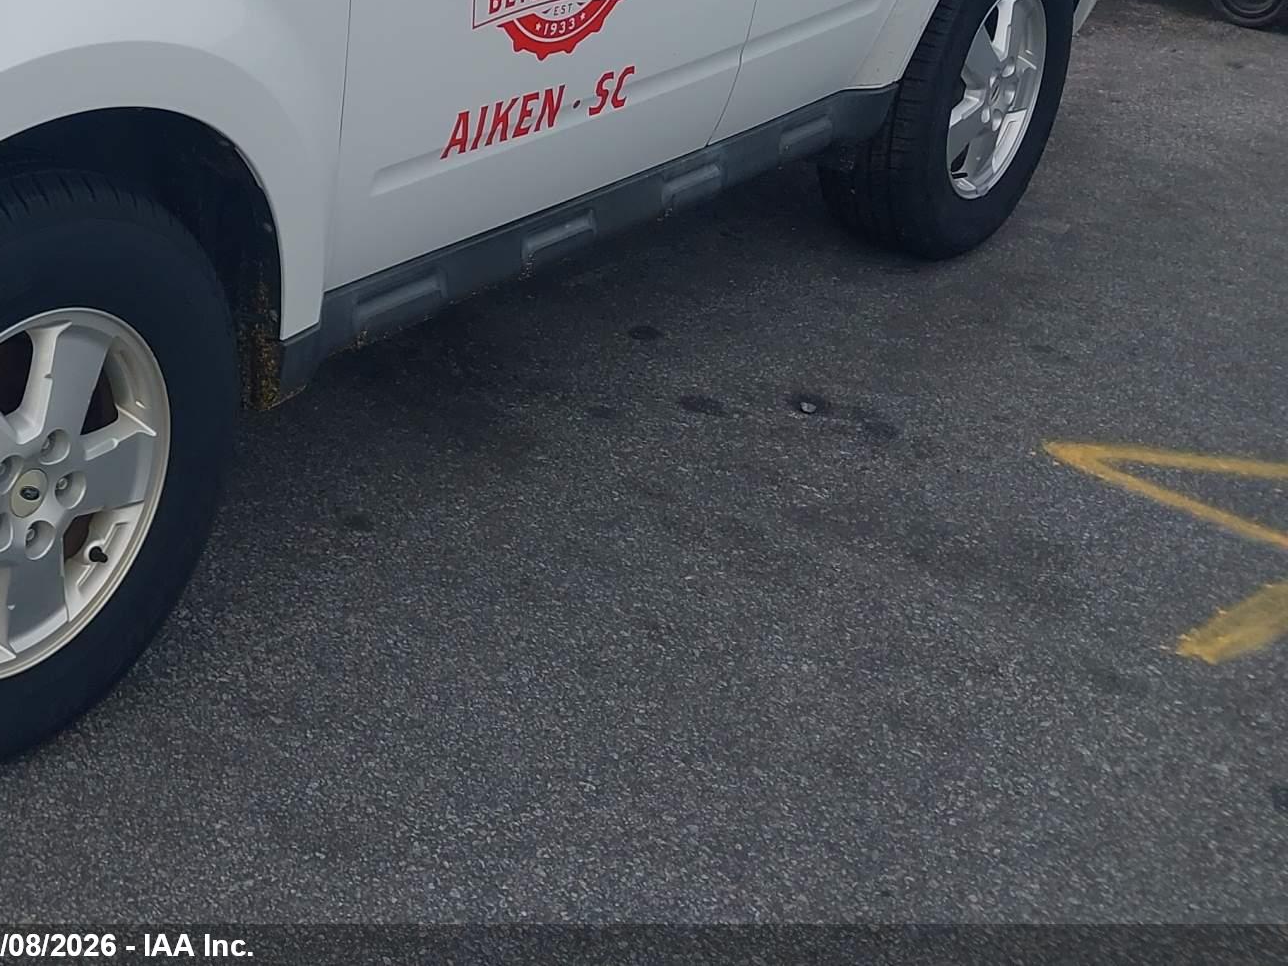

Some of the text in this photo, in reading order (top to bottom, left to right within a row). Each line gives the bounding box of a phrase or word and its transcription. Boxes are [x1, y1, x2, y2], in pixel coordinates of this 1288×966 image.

[553, 2, 574, 16] EST
[543, 17, 576, 36] 1933
[441, 65, 636, 160] AIKEN SC
